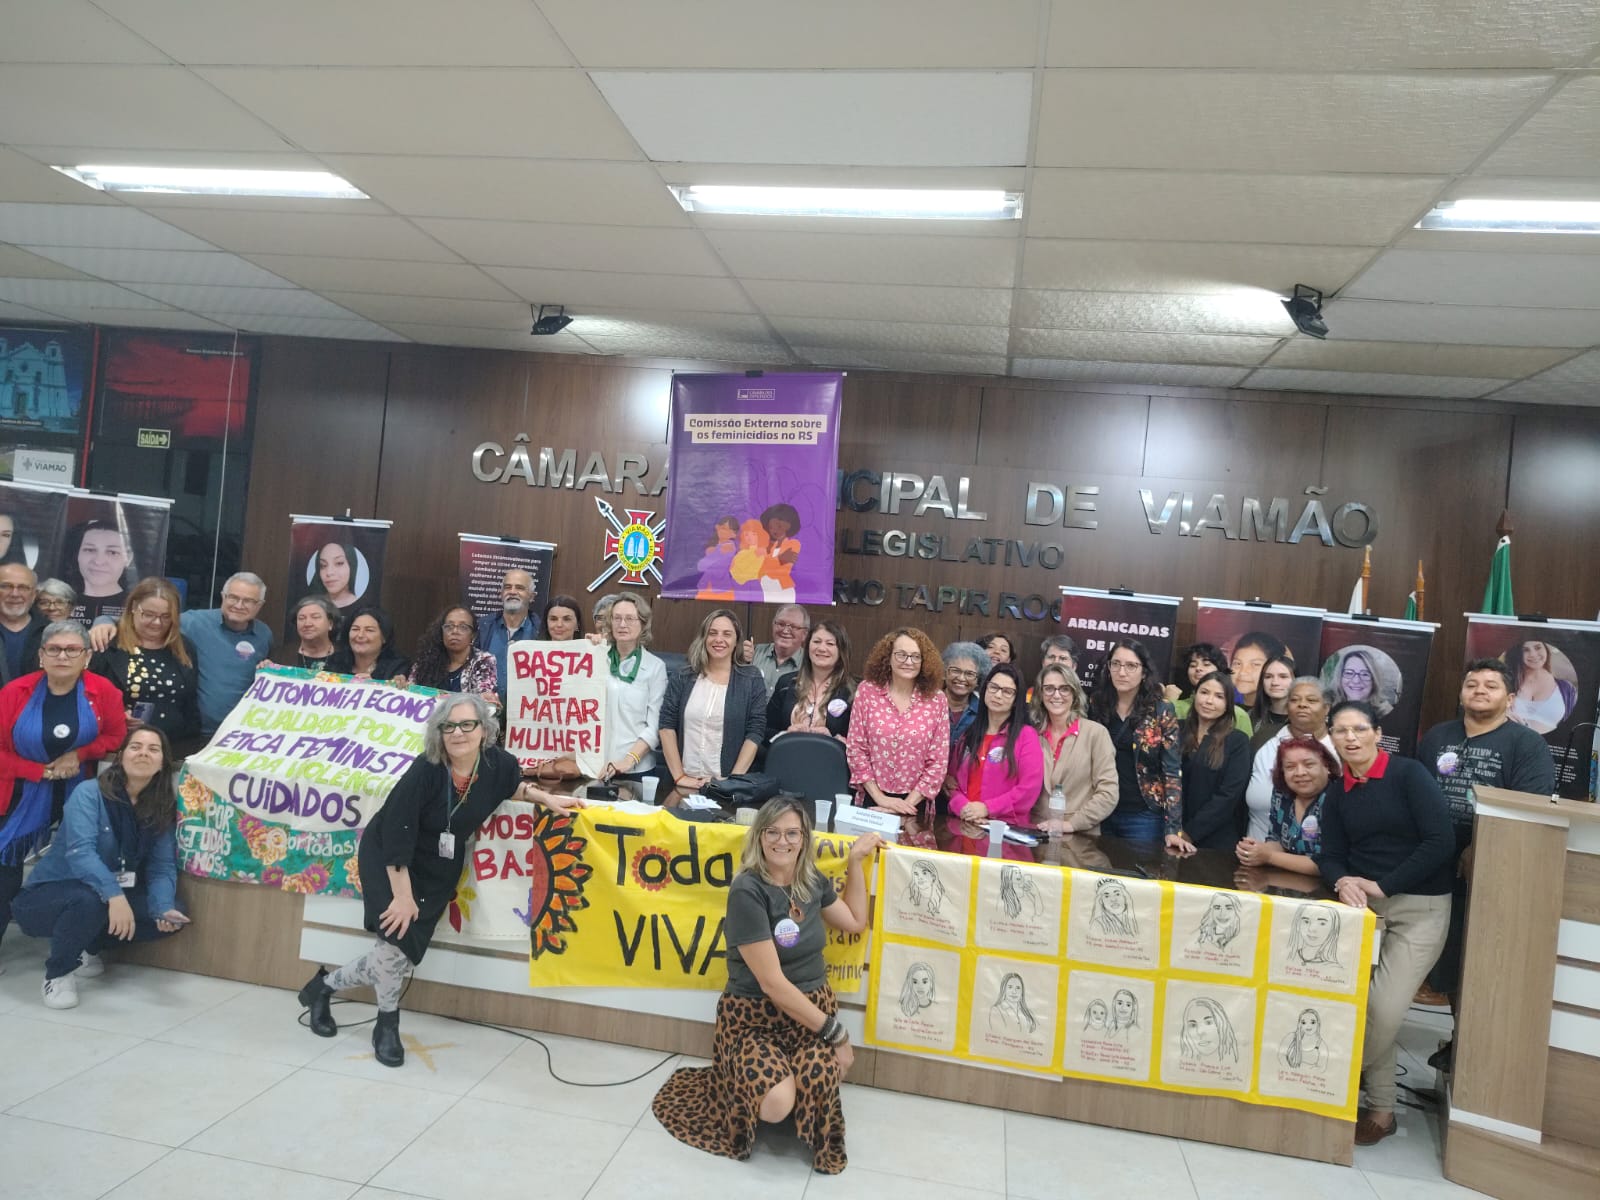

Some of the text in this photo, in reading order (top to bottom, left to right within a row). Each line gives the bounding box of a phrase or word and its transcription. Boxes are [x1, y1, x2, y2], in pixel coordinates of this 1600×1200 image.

[140, 431, 160, 445] SAÍDA
[689, 418, 822, 429] Comissão Externa sobre
[697, 431, 709, 440] os
[781, 432, 796, 441] no
[798, 431, 813, 441] RS
[1025, 480, 1099, 530] DE
[1139, 485, 1380, 549] VIAMÃO
[842, 529, 1066, 570] LEGISLATIVO
[896, 583, 990, 617] TAPIR
[1067, 617, 1170, 638] ARRANCADAS
[1086, 639, 1106, 651] DE
[512, 650, 594, 679] BASTA
[535, 677, 563, 697] DE
[520, 695, 600, 726] MATAR
[214, 730, 286, 754] ÉTICA
[508, 724, 601, 754] MULHER!
[244, 755, 284, 773] DA
[206, 802, 235, 833] POR
[184, 824, 232, 857] TODAS
[595, 823, 734, 888] Toda
